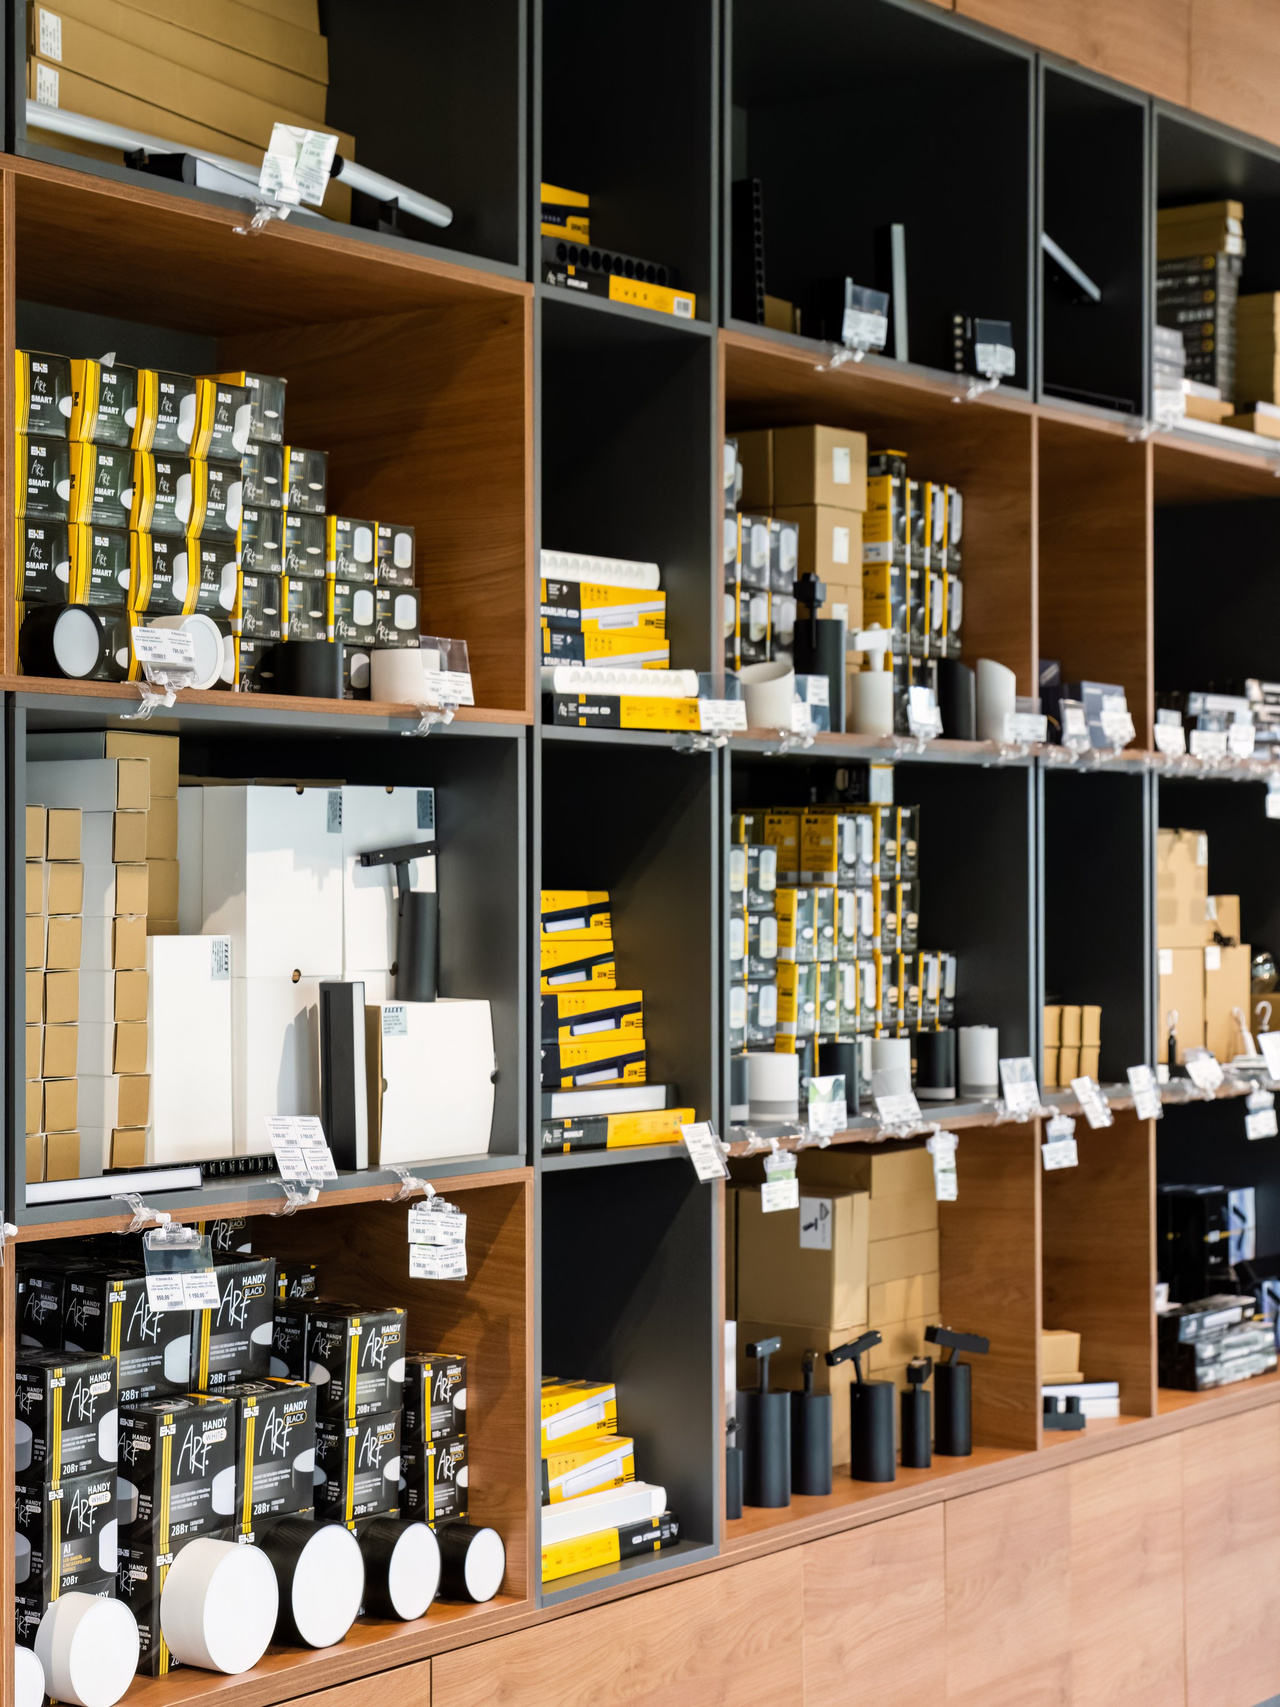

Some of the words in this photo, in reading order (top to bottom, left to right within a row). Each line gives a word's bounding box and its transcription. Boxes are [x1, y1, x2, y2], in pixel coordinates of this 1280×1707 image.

[31, 395, 52, 404] SMART
[99, 406, 119, 415] SMART
[28, 479, 50, 488] SMART
[94, 487, 115, 497] SMART
[26, 561, 48, 570] SMART
[243, 1274, 267, 1286] HANDY
[244, 1287, 262, 1296] BLACK
[90, 1371, 111, 1384] HANDY
[210, 1373, 226, 1384] 28Вт
[92, 1382, 109, 1392] WHITE
[121, 1390, 139, 1402] 28Вт
[284, 1400, 308, 1413] HANDY
[286, 1413, 304, 1424] BLACK
[202, 1418, 227, 1431] HANDY
[205, 1431, 224, 1441] WHITE
[63, 1463, 78, 1474] 20Вт
[88, 1482, 111, 1495] HANDY
[92, 1494, 108, 1503] WHITE
[171, 1524, 189, 1536] 28Вт
